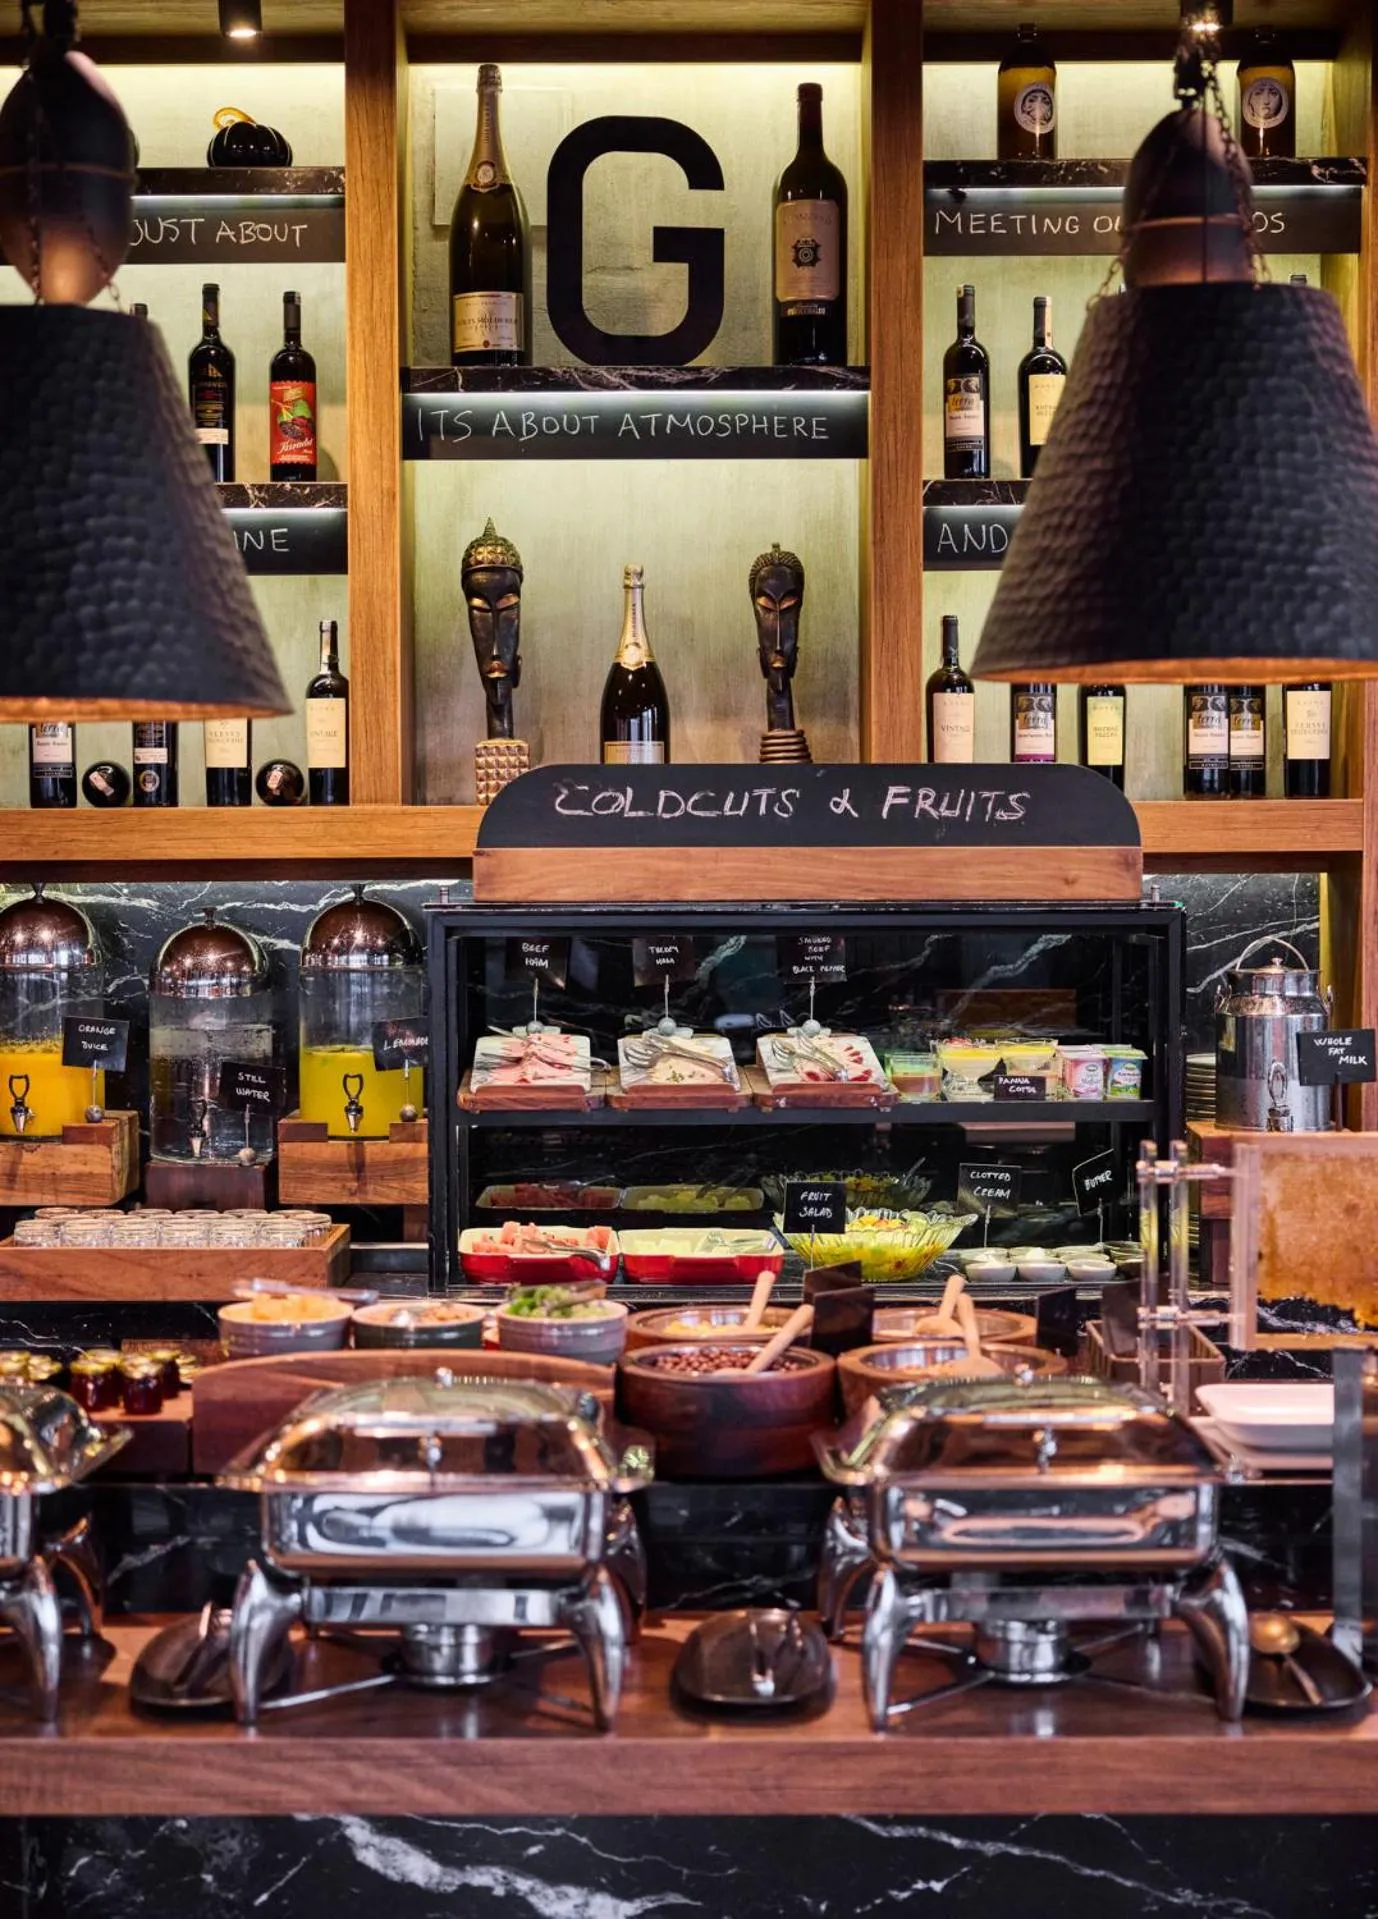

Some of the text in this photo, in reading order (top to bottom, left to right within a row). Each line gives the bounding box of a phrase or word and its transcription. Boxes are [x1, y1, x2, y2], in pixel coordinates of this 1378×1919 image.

[935, 210, 1080, 235] MEETING
[129, 216, 308, 248] JUST ABOUT
[547, 115, 725, 367] G
[418, 407, 830, 443] ITS ABOUT ATMOSPHERE
[232, 527, 291, 553] INE
[936, 523, 1009, 554] AND
[553, 782, 800, 819] COLDCUTS
[881, 785, 1031, 822] FRUITS
[521, 942, 550, 953] BEEF
[524, 956, 549, 969] HAM
[78, 1024, 116, 1036] ORANGE
[81, 1040, 109, 1051] JUICE
[1312, 1036, 1353, 1047] WHOLE
[1327, 1047, 1346, 1056] FAT
[1337, 1055, 1368, 1066] MILK
[998, 1076, 1031, 1085] PANNA
[235, 1087, 271, 1103] WATER
[970, 1171, 1011, 1182] CLOTTED
[800, 1190, 833, 1202] FRUIT
[972, 1185, 1012, 1200] CREAM
[798, 1205, 833, 1219] SALAD
